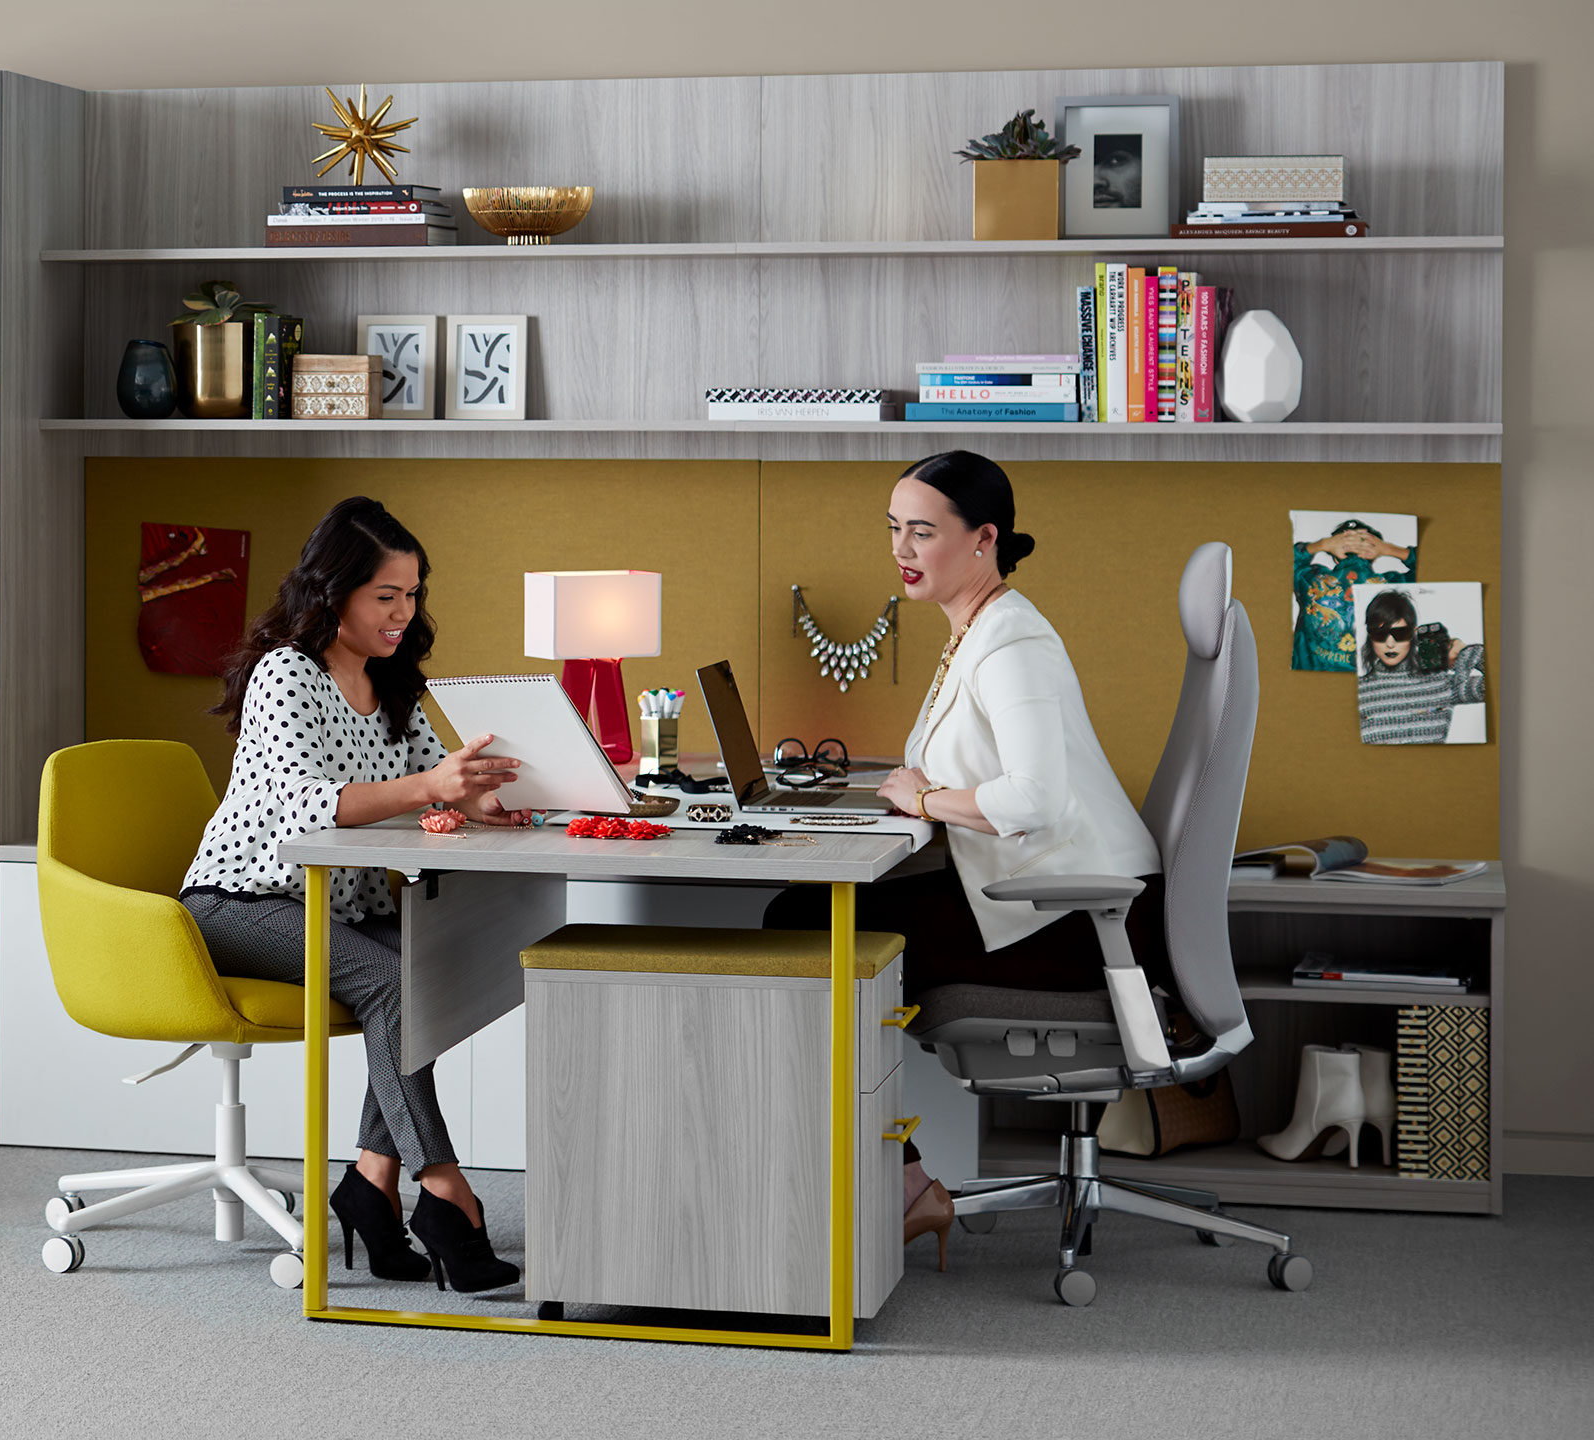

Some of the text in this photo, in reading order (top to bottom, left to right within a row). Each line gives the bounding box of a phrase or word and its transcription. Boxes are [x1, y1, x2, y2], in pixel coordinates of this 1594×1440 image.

[269, 230, 351, 242] OBJECTS OF DESIRE
[1080, 291, 1092, 333] MASSIVE
[1083, 335, 1094, 371] CHANGE
[1200, 339, 1208, 375] FASHION
[936, 389, 990, 400] HELLO
[757, 407, 829, 417] IRIS VAN HERPEN
[941, 407, 1036, 417] The Anatomy of Fashion
